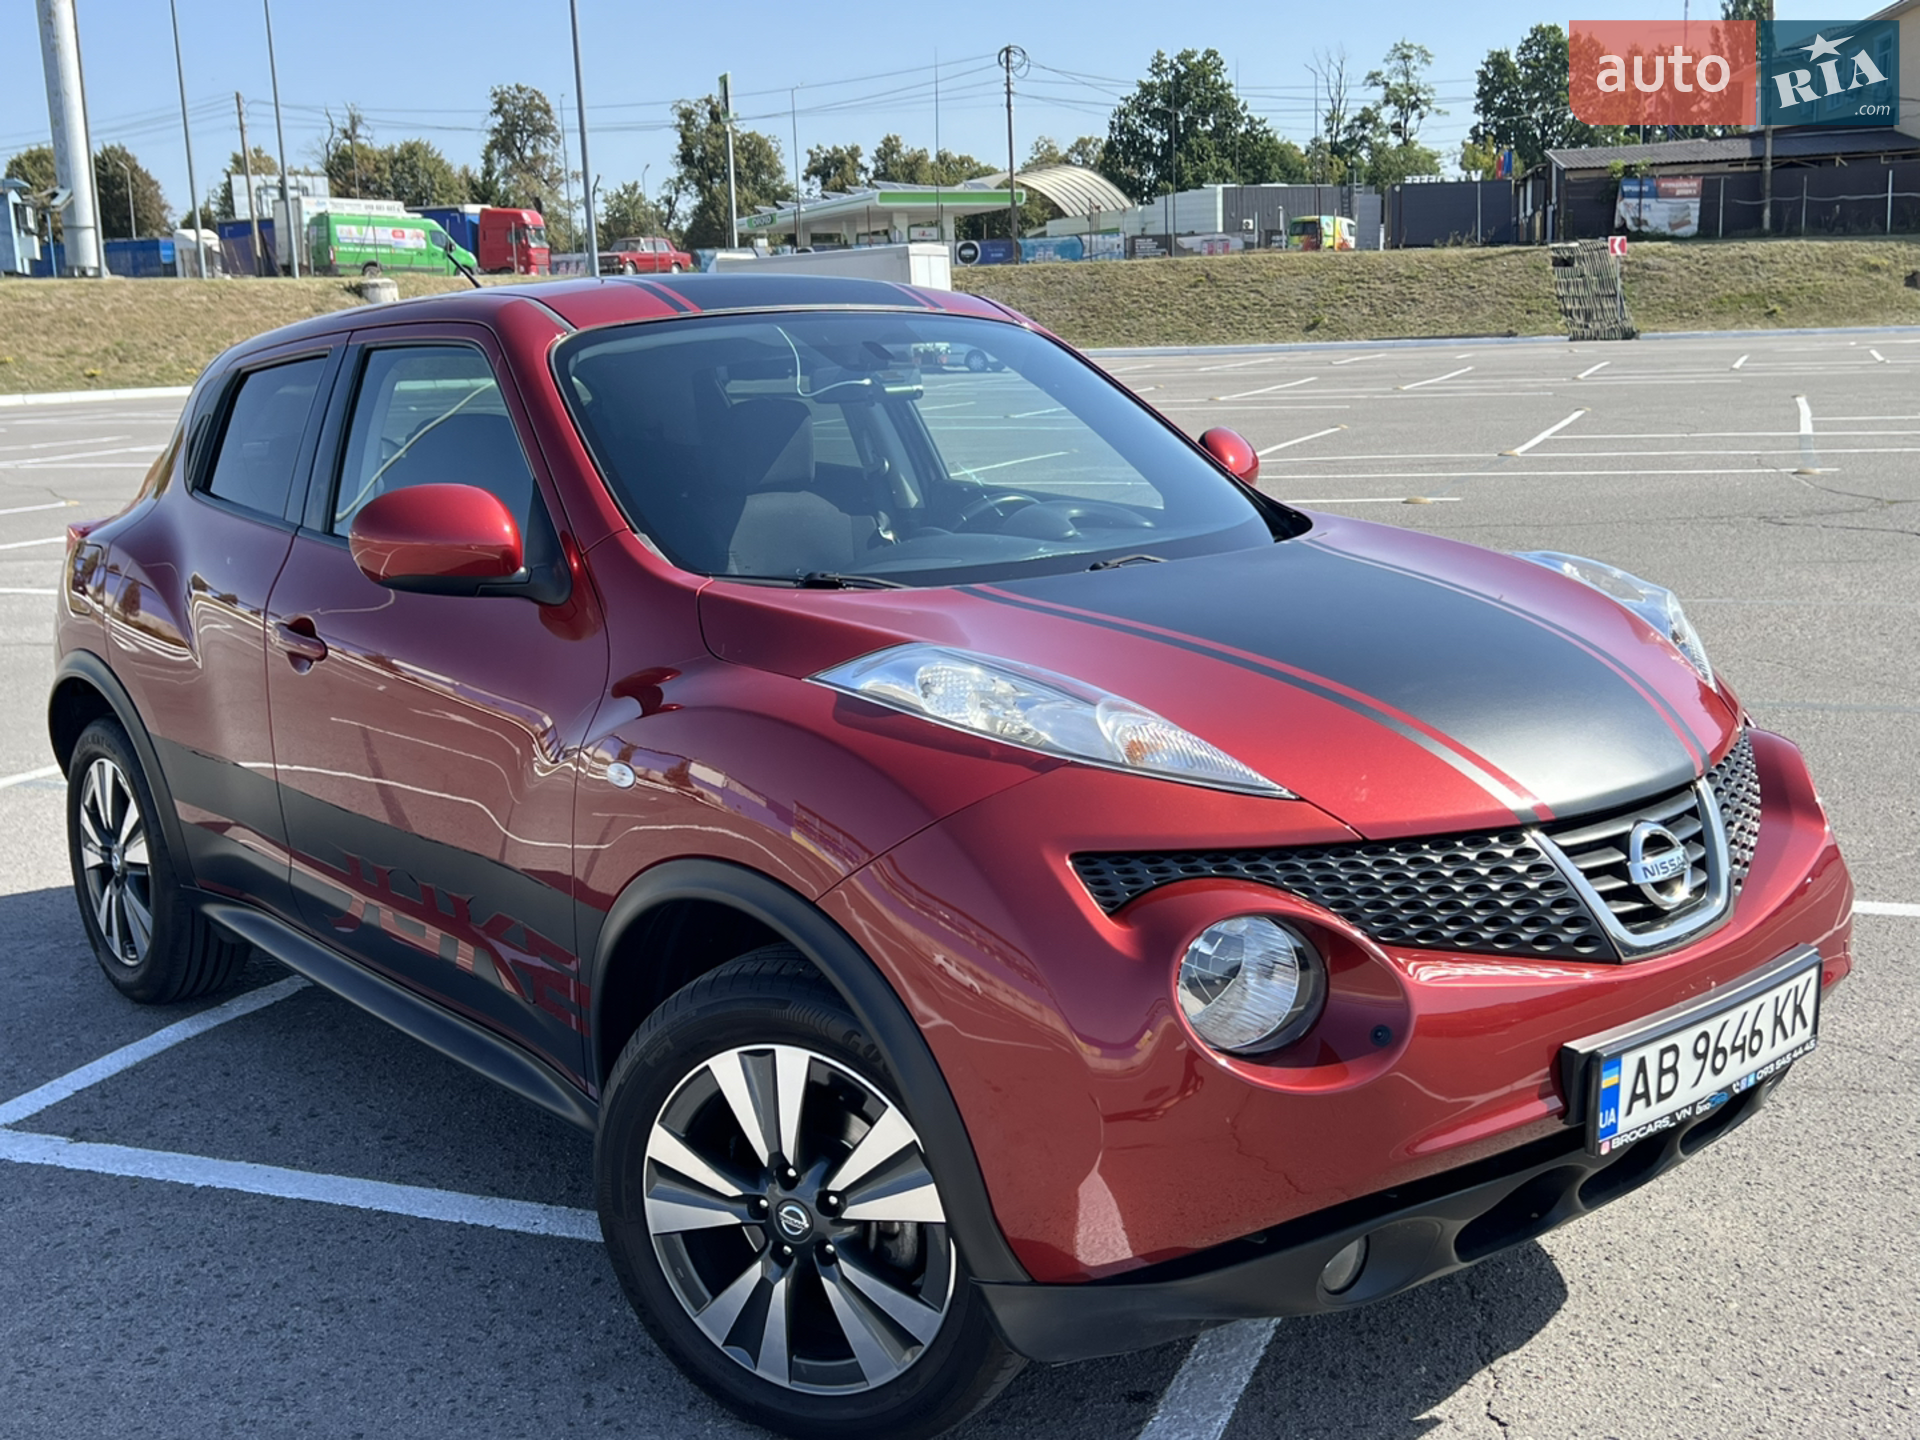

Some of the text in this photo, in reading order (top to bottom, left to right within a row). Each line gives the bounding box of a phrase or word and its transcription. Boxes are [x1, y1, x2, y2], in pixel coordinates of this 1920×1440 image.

[1625, 975, 1814, 1118] AB 9646 KK
[1598, 1107, 1617, 1129] UA
